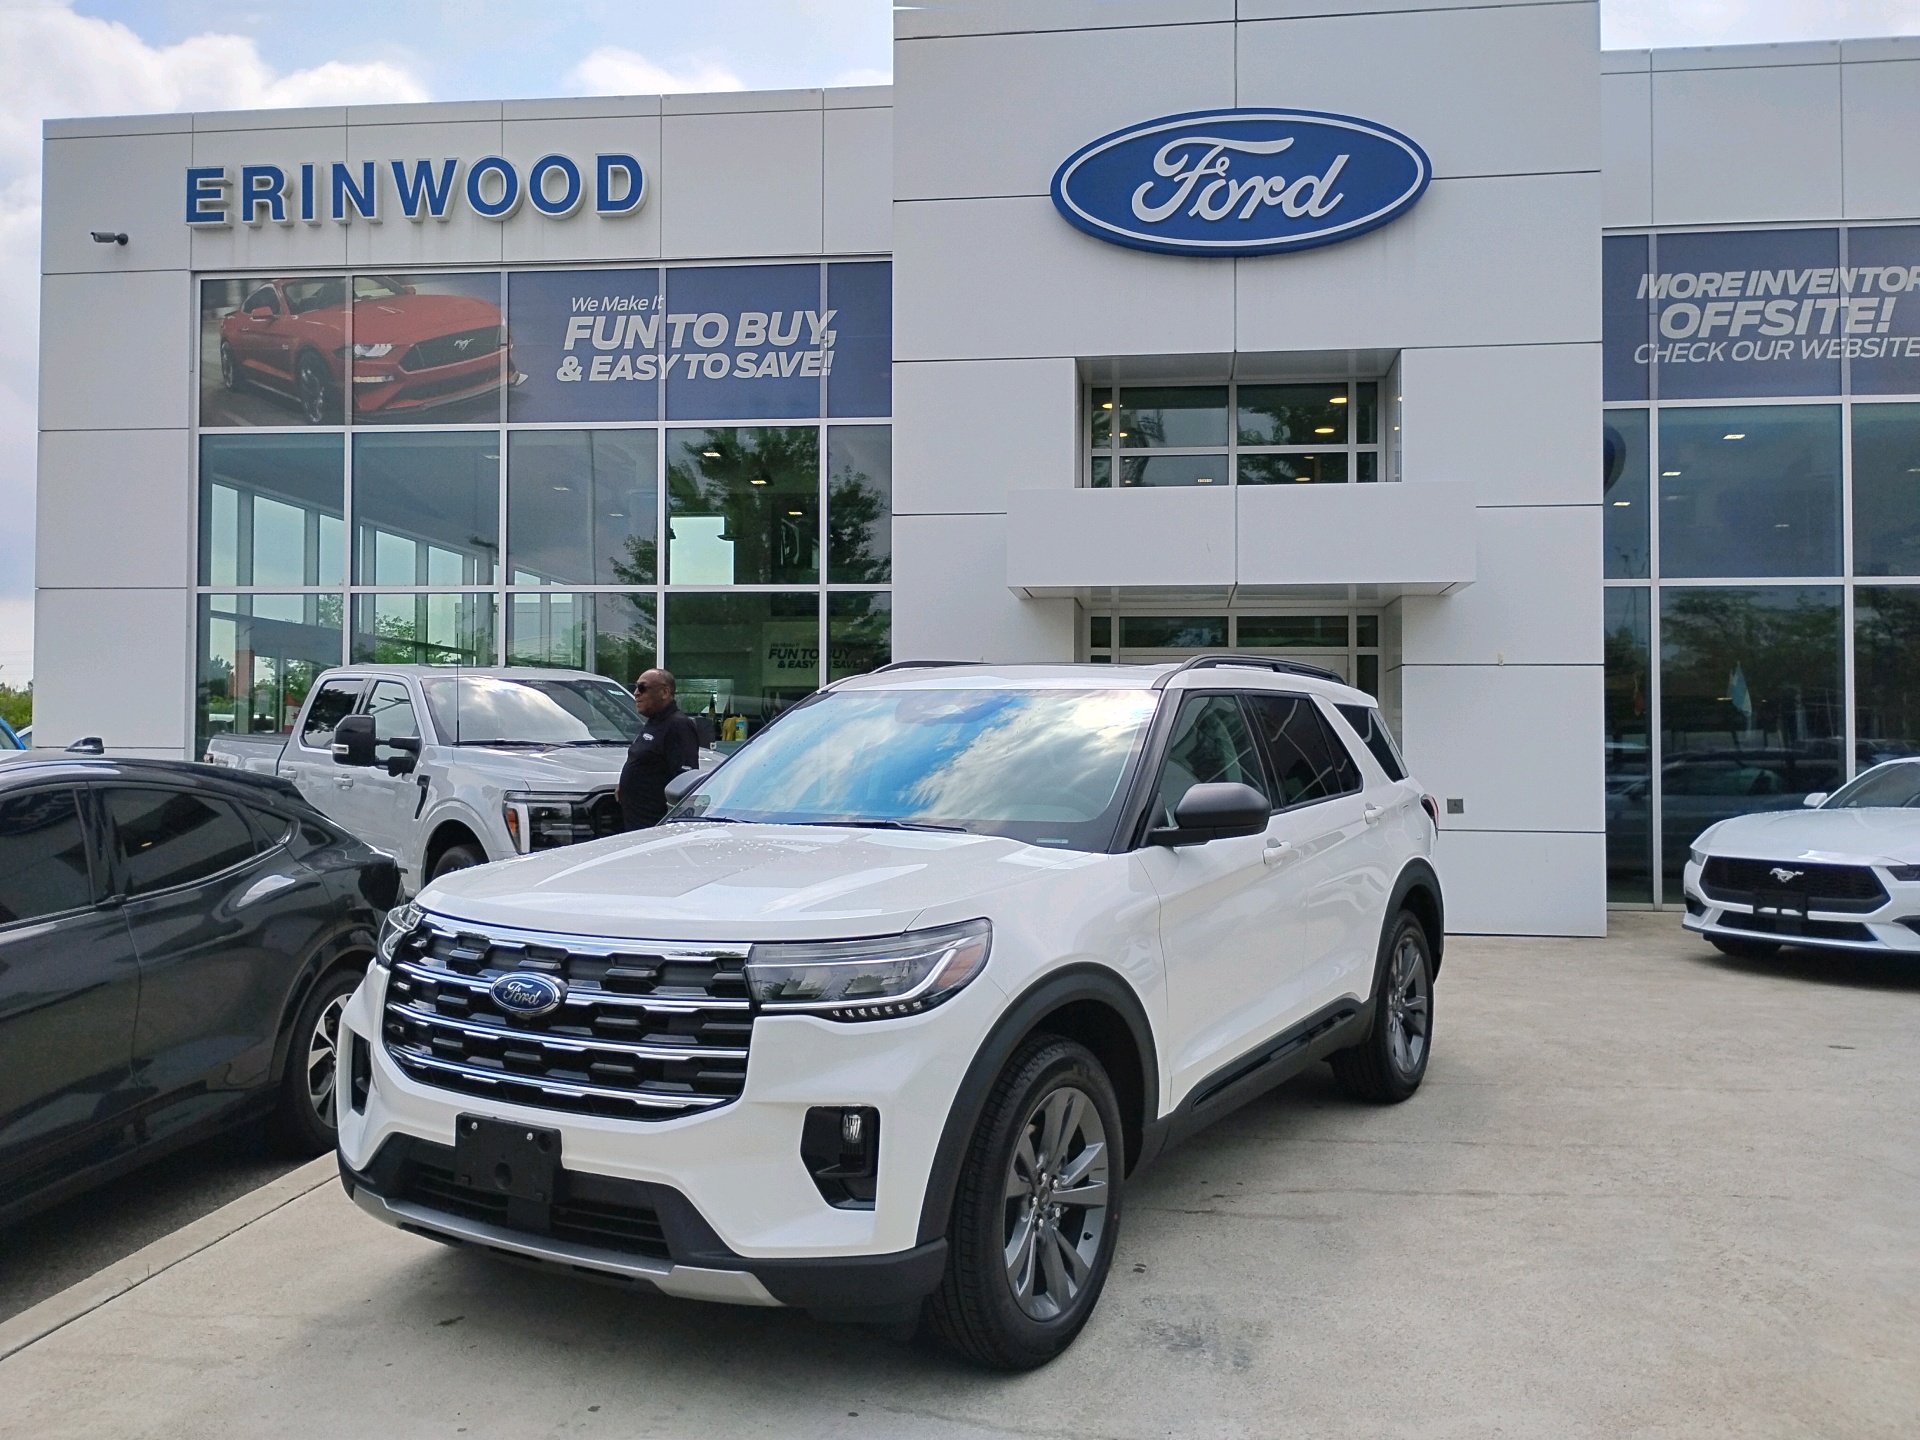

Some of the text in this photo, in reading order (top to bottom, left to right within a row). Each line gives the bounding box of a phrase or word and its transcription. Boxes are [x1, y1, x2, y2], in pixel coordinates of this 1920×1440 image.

[185, 152, 649, 229] ERINWOOD
[1131, 136, 1350, 223] Ford
[1636, 270, 1746, 300] MORE
[571, 294, 665, 312] We Make It
[1659, 296, 1897, 340] OFFSITE!
[563, 309, 838, 350] FUN TO BUY,
[1634, 336, 1920, 365] CHECK OUR WEBSITE
[556, 350, 834, 382] & EASY TO SAVE!
[768, 648, 799, 660] FUN
[801, 648, 819, 660] TO
[777, 660, 786, 669] &
[787, 660, 816, 669] EASY
[503, 981, 542, 1006] Ford
